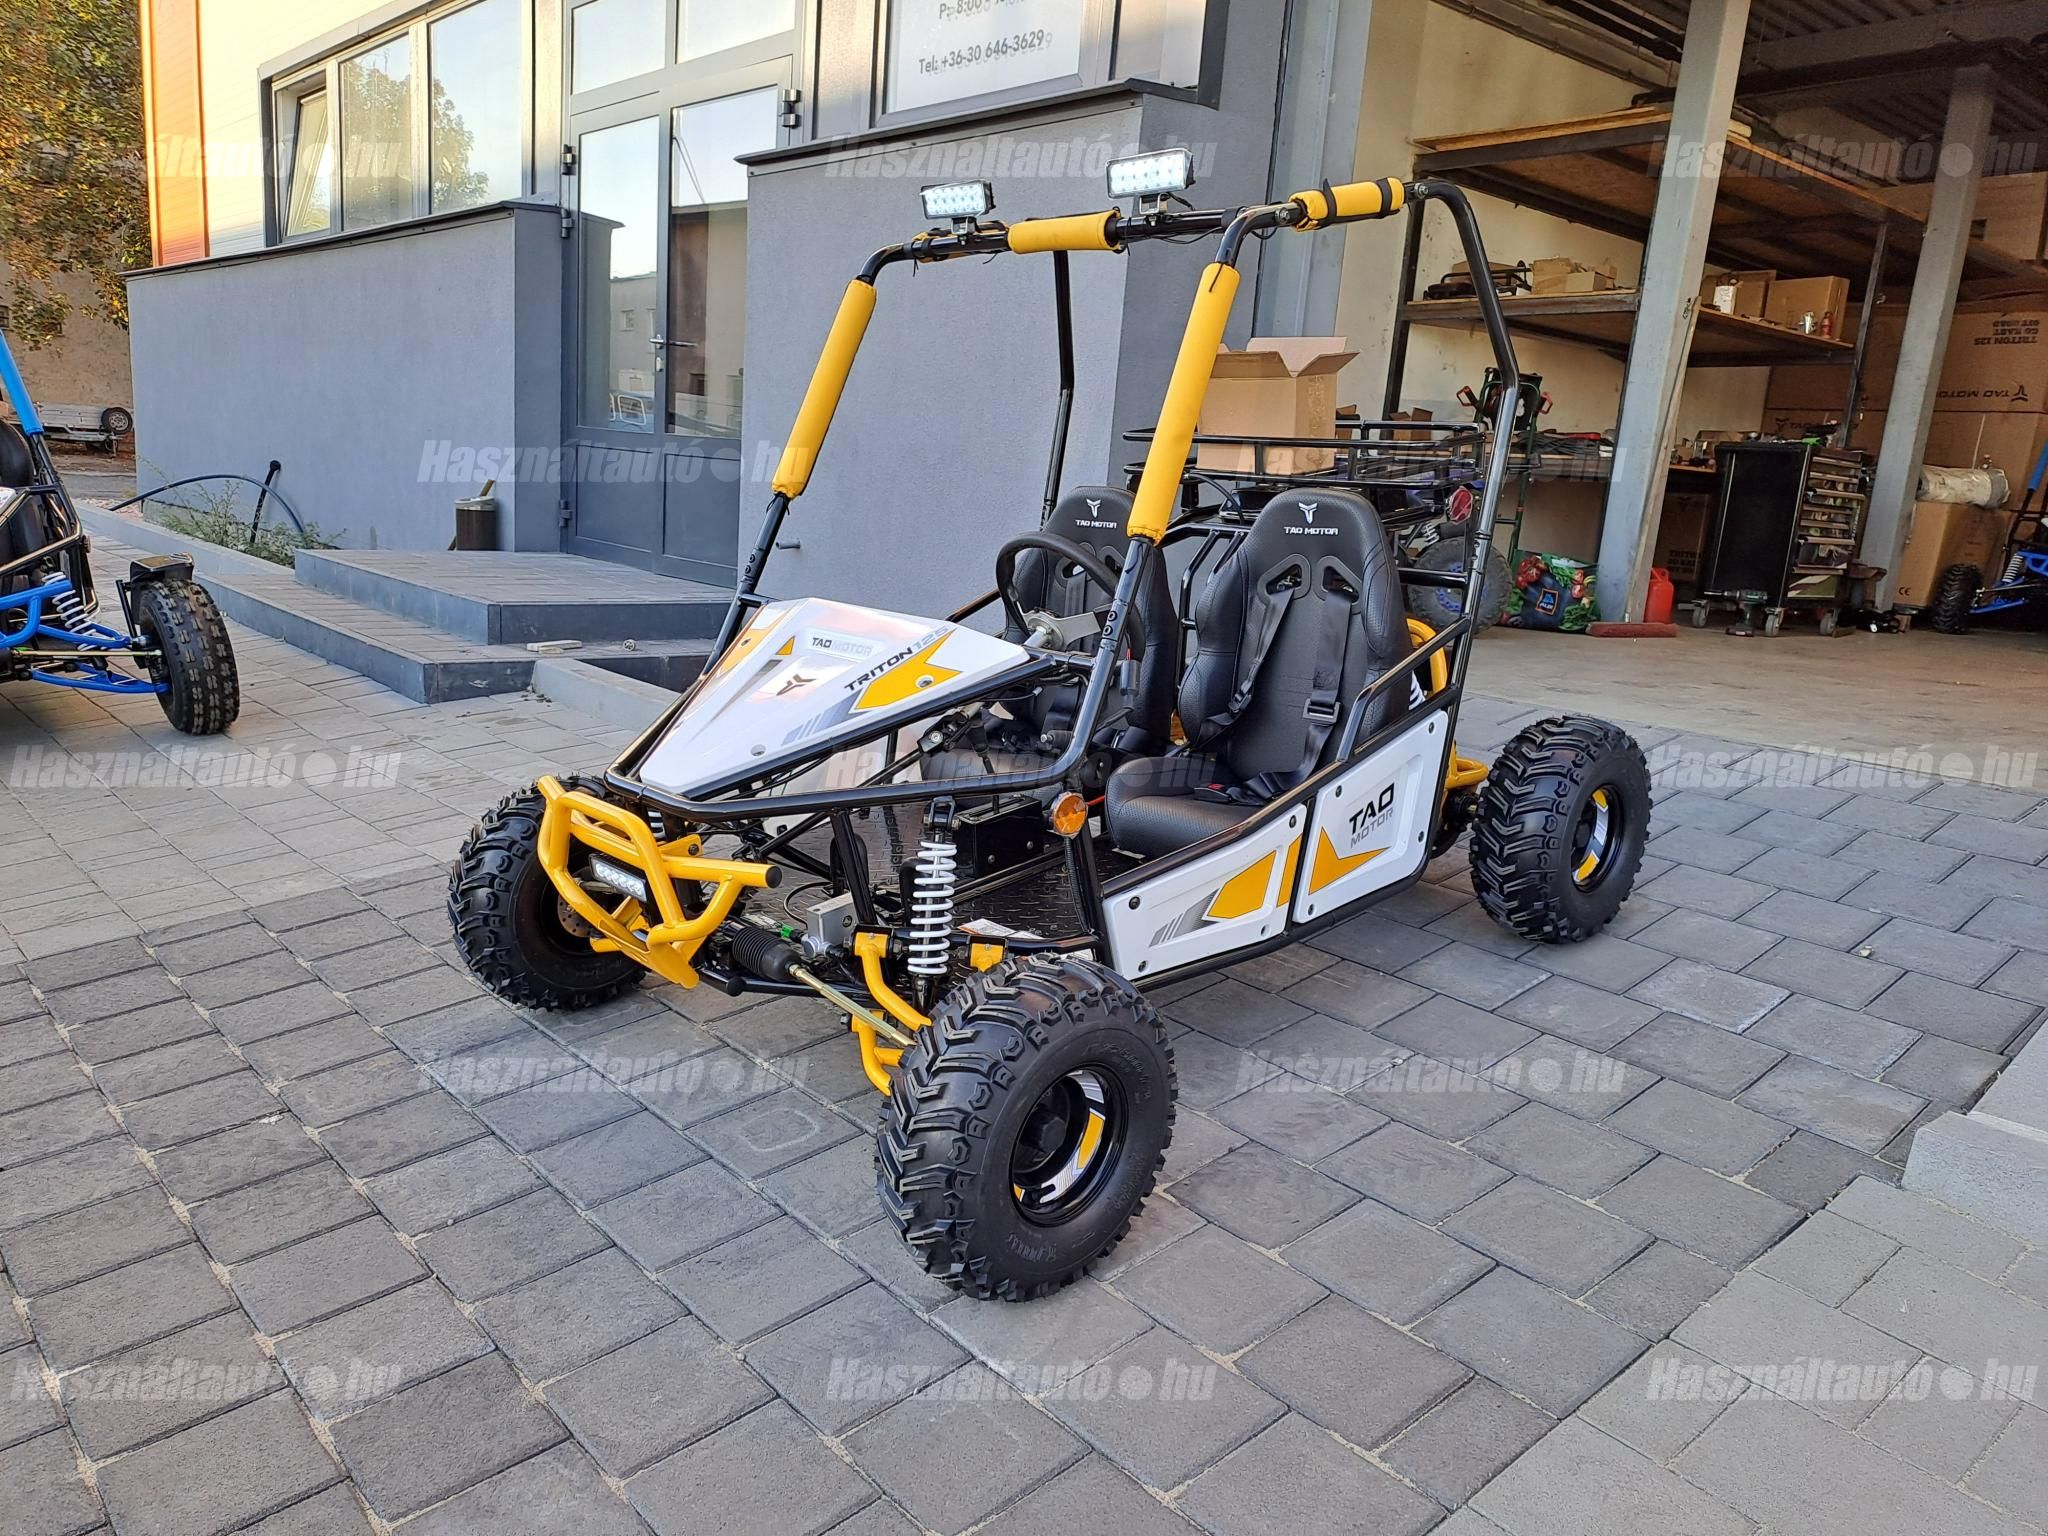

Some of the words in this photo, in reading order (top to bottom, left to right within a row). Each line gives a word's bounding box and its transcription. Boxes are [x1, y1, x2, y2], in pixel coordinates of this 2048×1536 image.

[919, 55, 938, 74] Tel:
[941, 45, 982, 68] +36-30
[985, 29, 1045, 58] 646-3629
[1075, 519, 1091, 528] TAO
[1091, 520, 1117, 529] MOTOR
[1283, 526, 1303, 534] TAO
[1304, 527, 1339, 536] MOTOR
[812, 637, 833, 648] TAO
[833, 642, 873, 656] MOTOR
[1349, 782, 1395, 836] TAO
[1350, 807, 1394, 849] MOTOR
